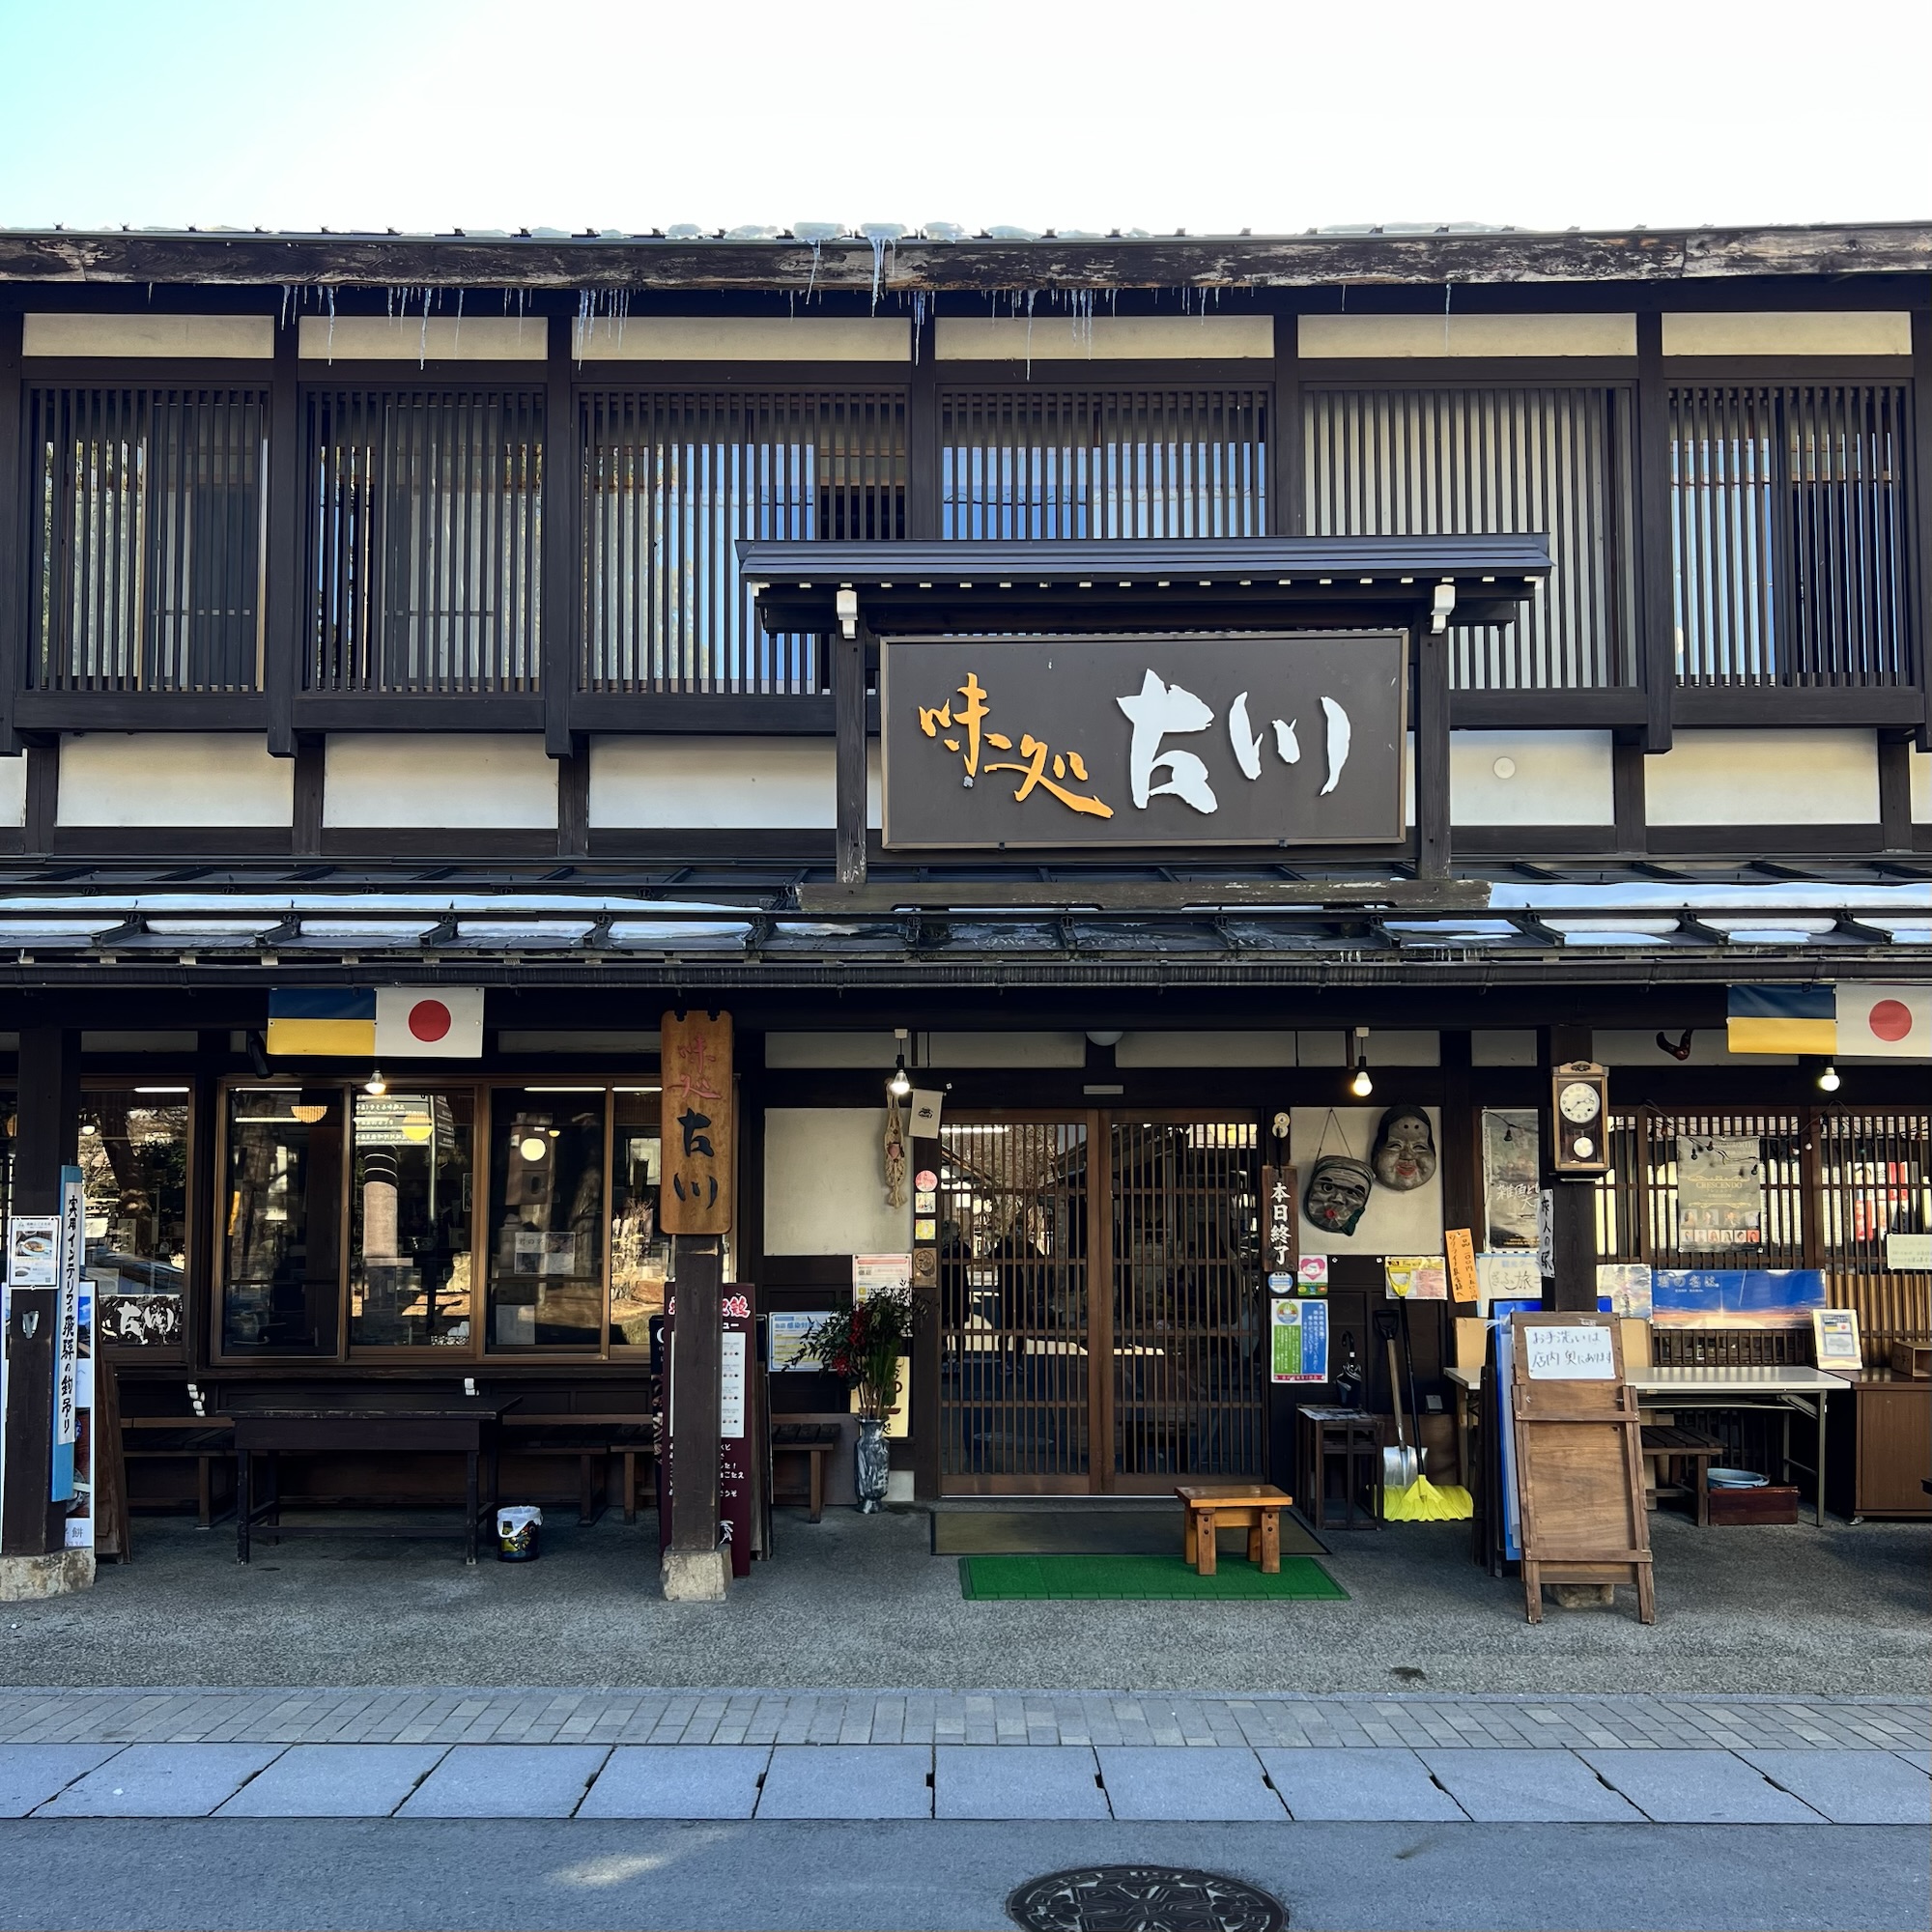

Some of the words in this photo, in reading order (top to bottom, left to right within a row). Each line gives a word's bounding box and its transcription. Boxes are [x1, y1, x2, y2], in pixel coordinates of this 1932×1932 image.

[919, 672, 1114, 818] 味処
[1116, 668, 1350, 814] 古川
[673, 1107, 719, 1210] 古川
[1270, 1182, 1292, 1265] 本日終了
[1532, 1330, 1602, 1345] お手洗いは
